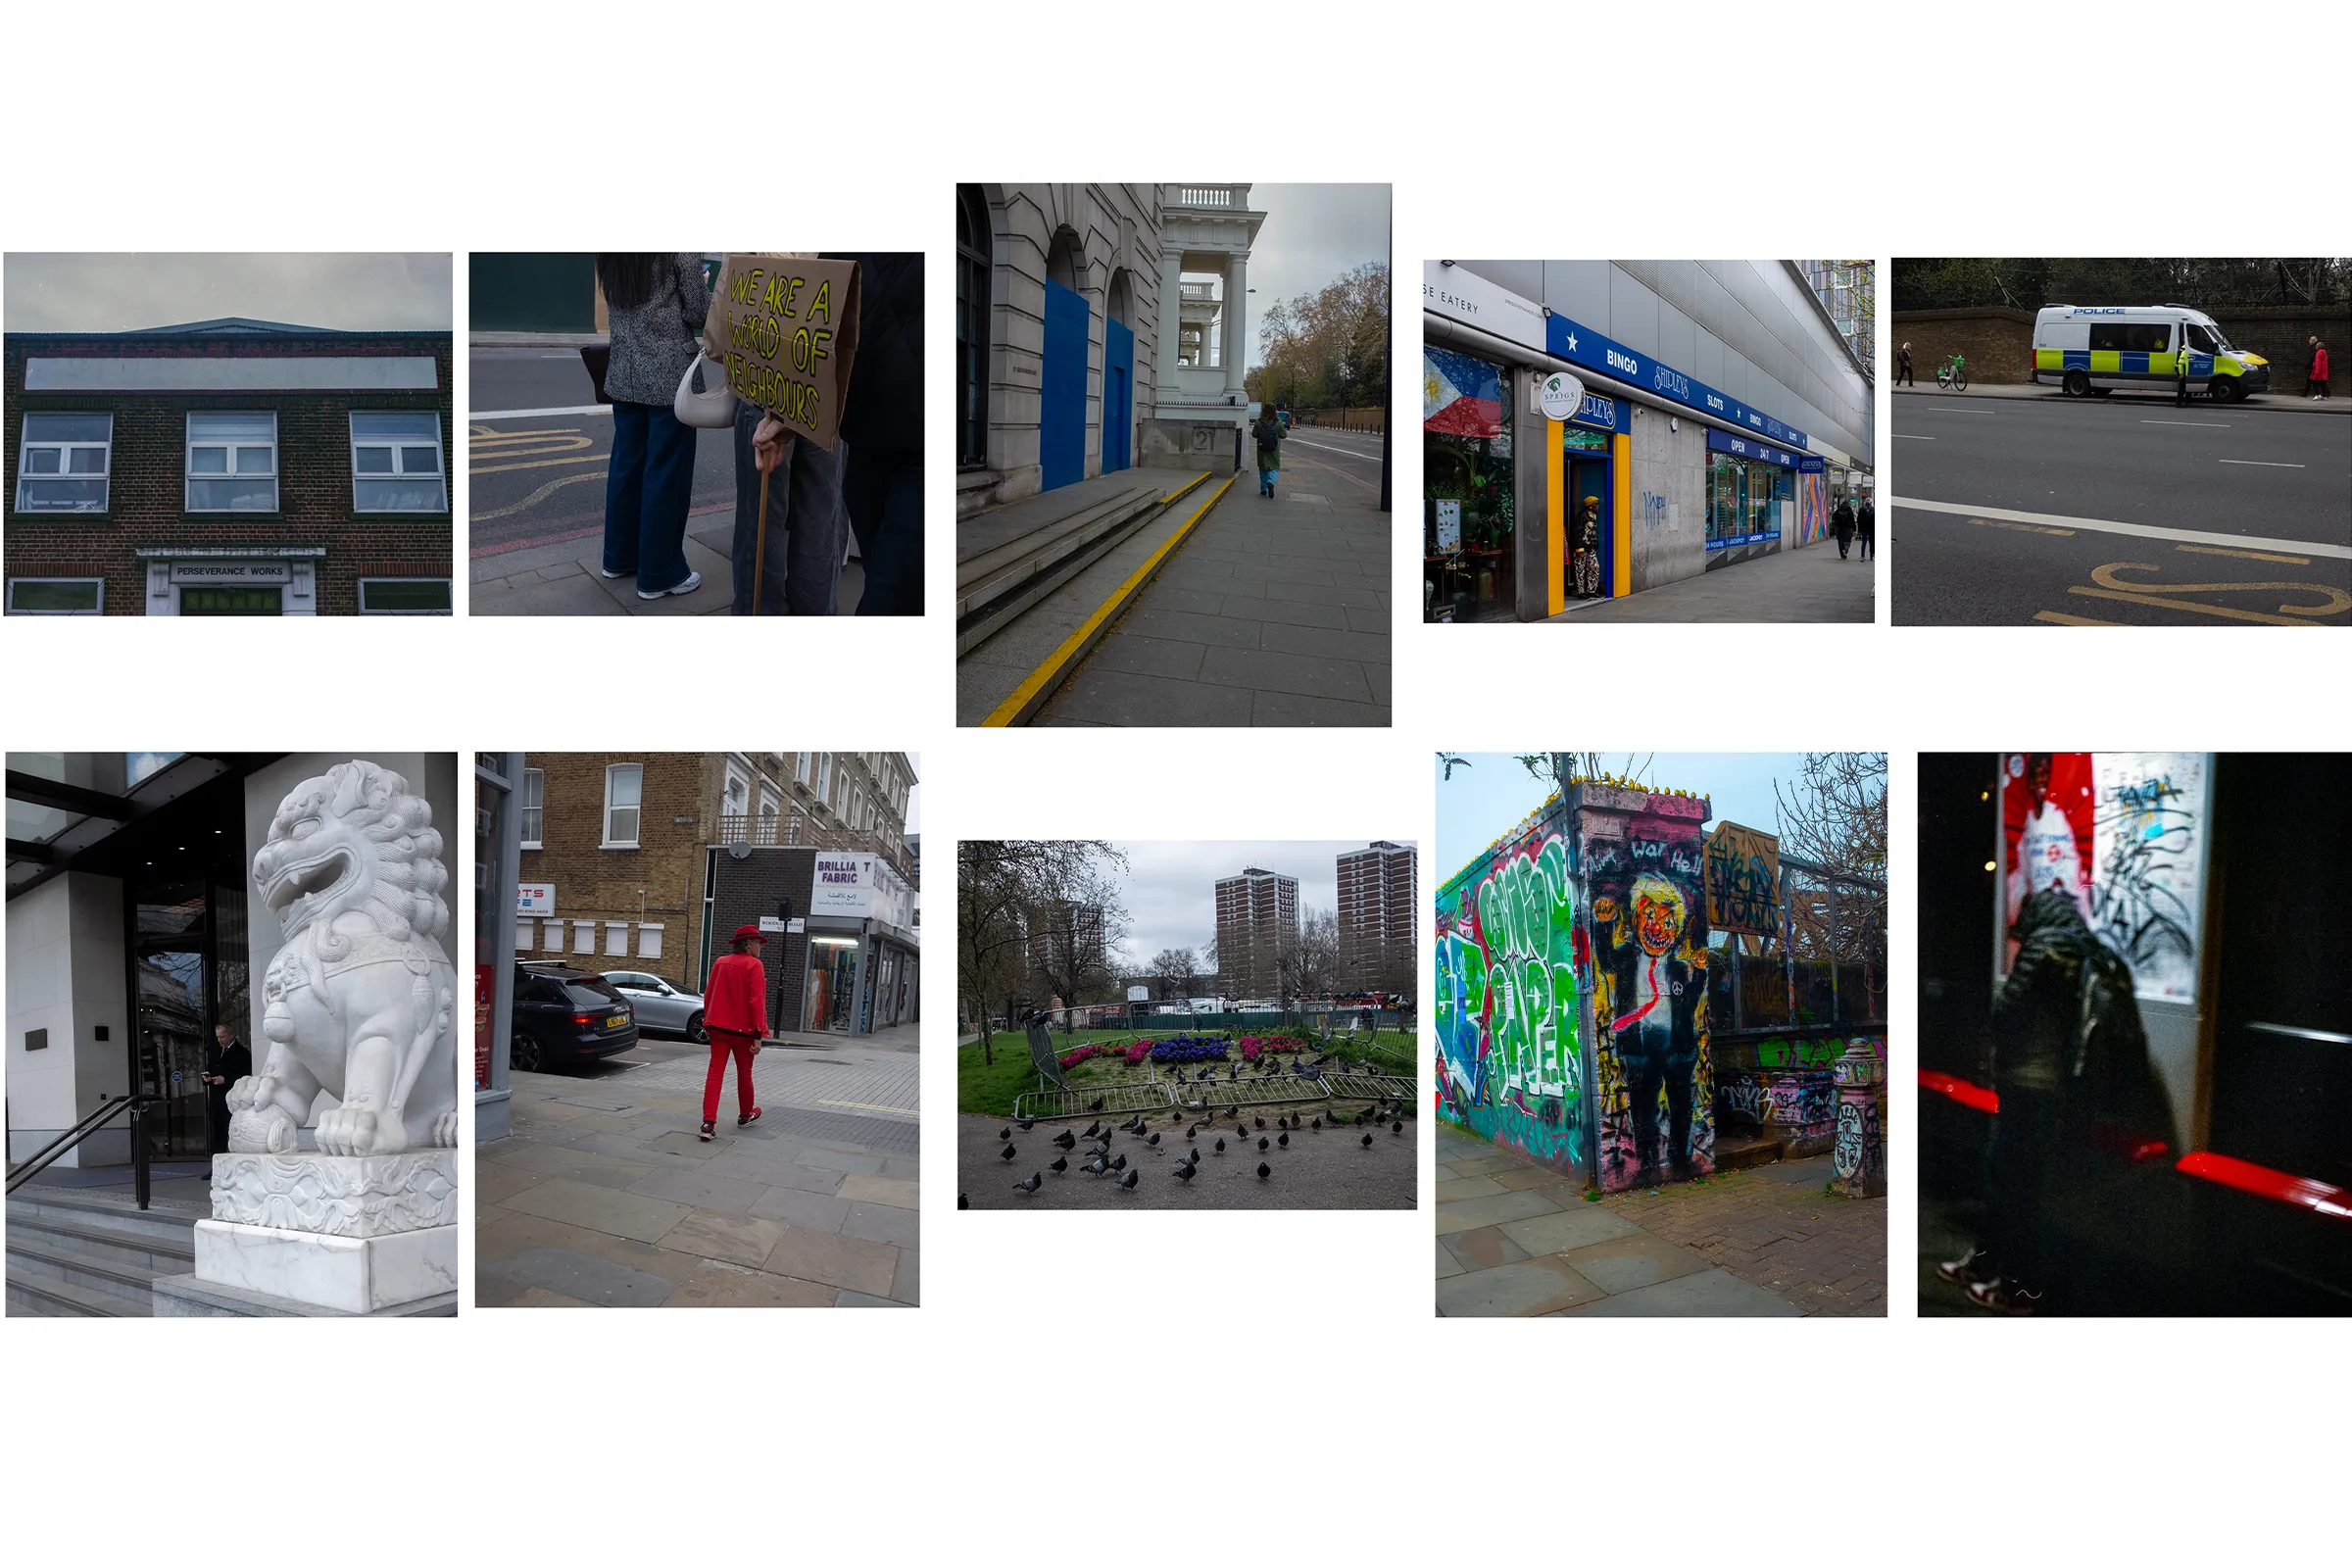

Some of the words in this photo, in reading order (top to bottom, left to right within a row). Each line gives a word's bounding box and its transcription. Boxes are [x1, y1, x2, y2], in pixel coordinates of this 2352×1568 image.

[730, 269, 763, 306] WE
[760, 272, 806, 318] ARE
[806, 279, 830, 325] A
[1441, 291, 1479, 315] EATERY
[728, 310, 780, 361] WORLD
[791, 326, 832, 377] OF
[724, 349, 819, 431] NEIGHBOURS
[1607, 349, 1638, 375] BINGO
[1707, 394, 1724, 412] SLOTS
[1749, 413, 1762, 427] BINGO
[1195, 430, 1215, 451] 21
[1731, 439, 1745, 453] OPEN
[1781, 454, 1790, 465] OPEN
[1710, 540, 1724, 549] HOURS
[177, 567, 245, 576] PERSEVERANCE
[250, 567, 283, 576] WORKS
[822, 872, 858, 883] FABRIC
